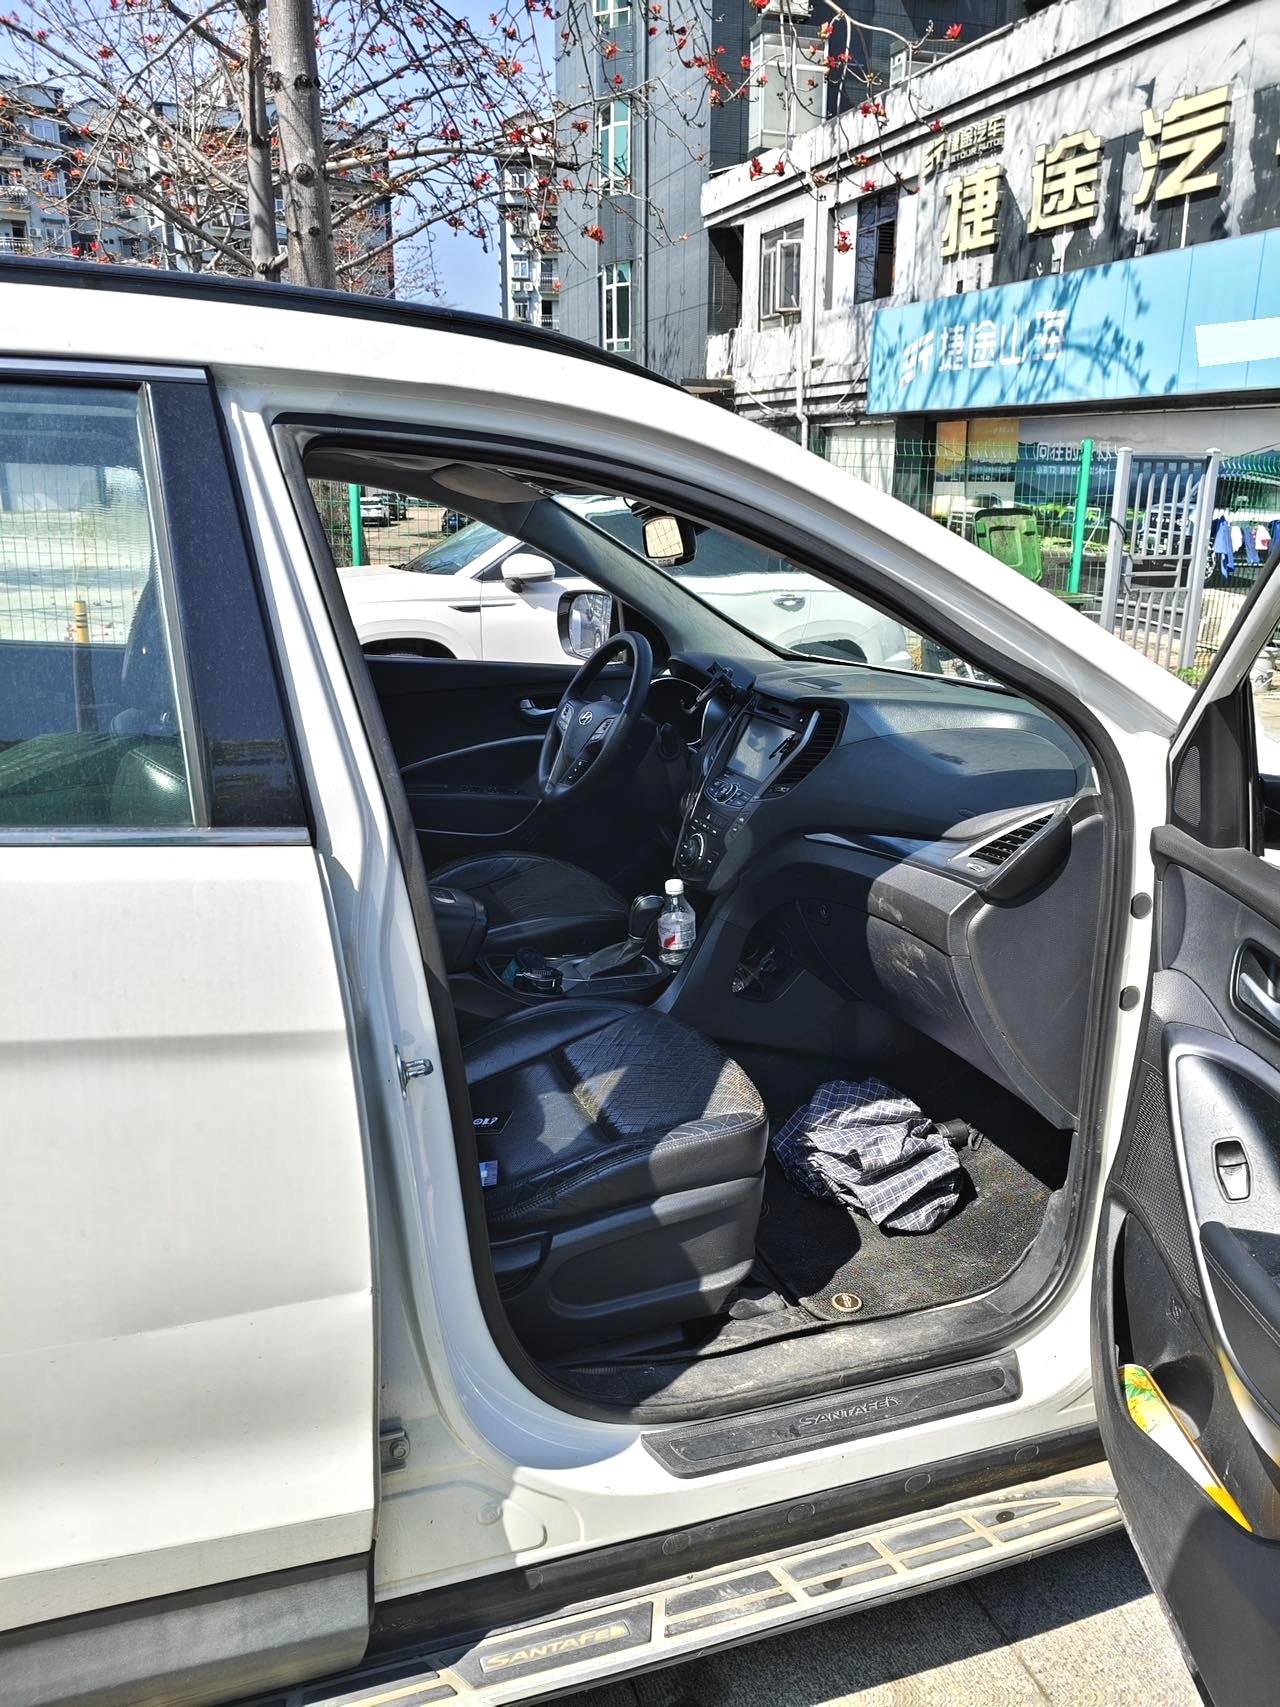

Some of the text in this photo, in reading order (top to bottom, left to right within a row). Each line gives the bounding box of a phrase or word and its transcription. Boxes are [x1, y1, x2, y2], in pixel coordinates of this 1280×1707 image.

[949, 114, 1005, 153] 捷途汽车
[978, 138, 1001, 151] AUTO
[941, 84, 1280, 258] 捷途汽
[938, 309, 1066, 373] 捷途山海
[485, 1627, 610, 1668] SANTAFE
